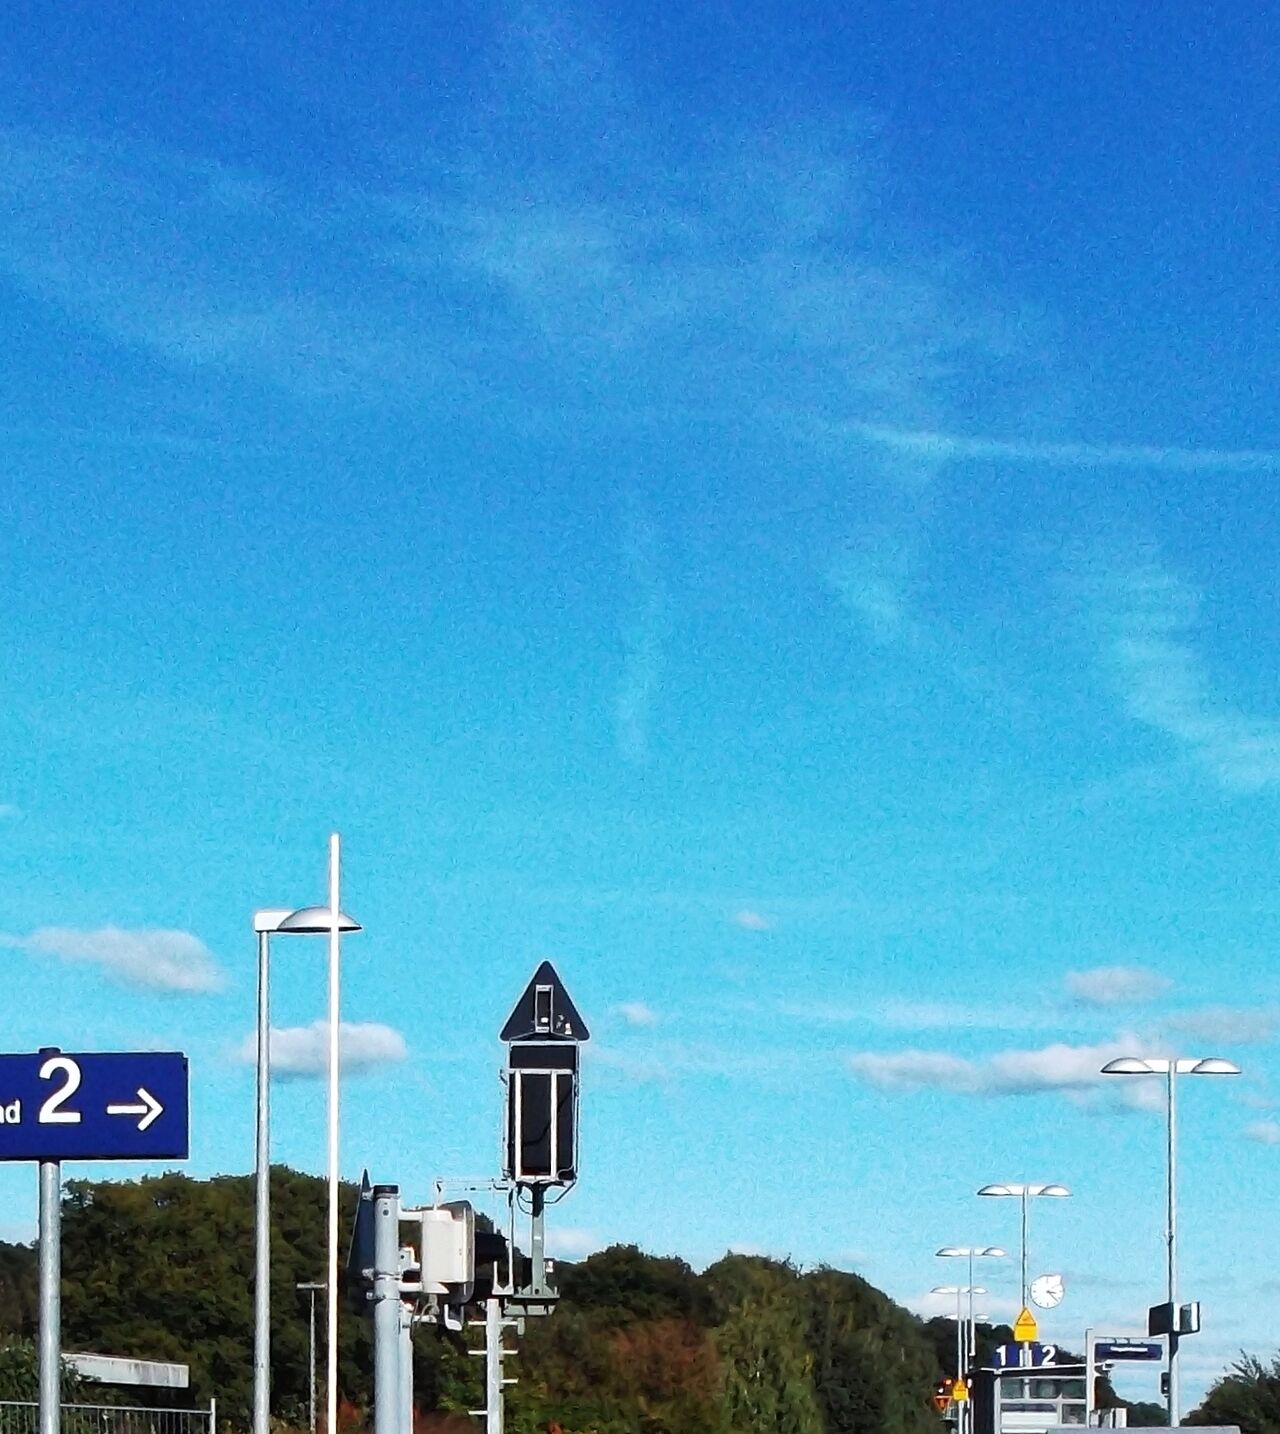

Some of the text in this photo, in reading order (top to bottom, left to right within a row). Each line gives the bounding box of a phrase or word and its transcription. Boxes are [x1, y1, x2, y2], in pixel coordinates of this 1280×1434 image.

[38, 1057, 81, 1124] 2
[995, 1344, 1007, 1367] 1
[1041, 1345, 1057, 1367] 2
